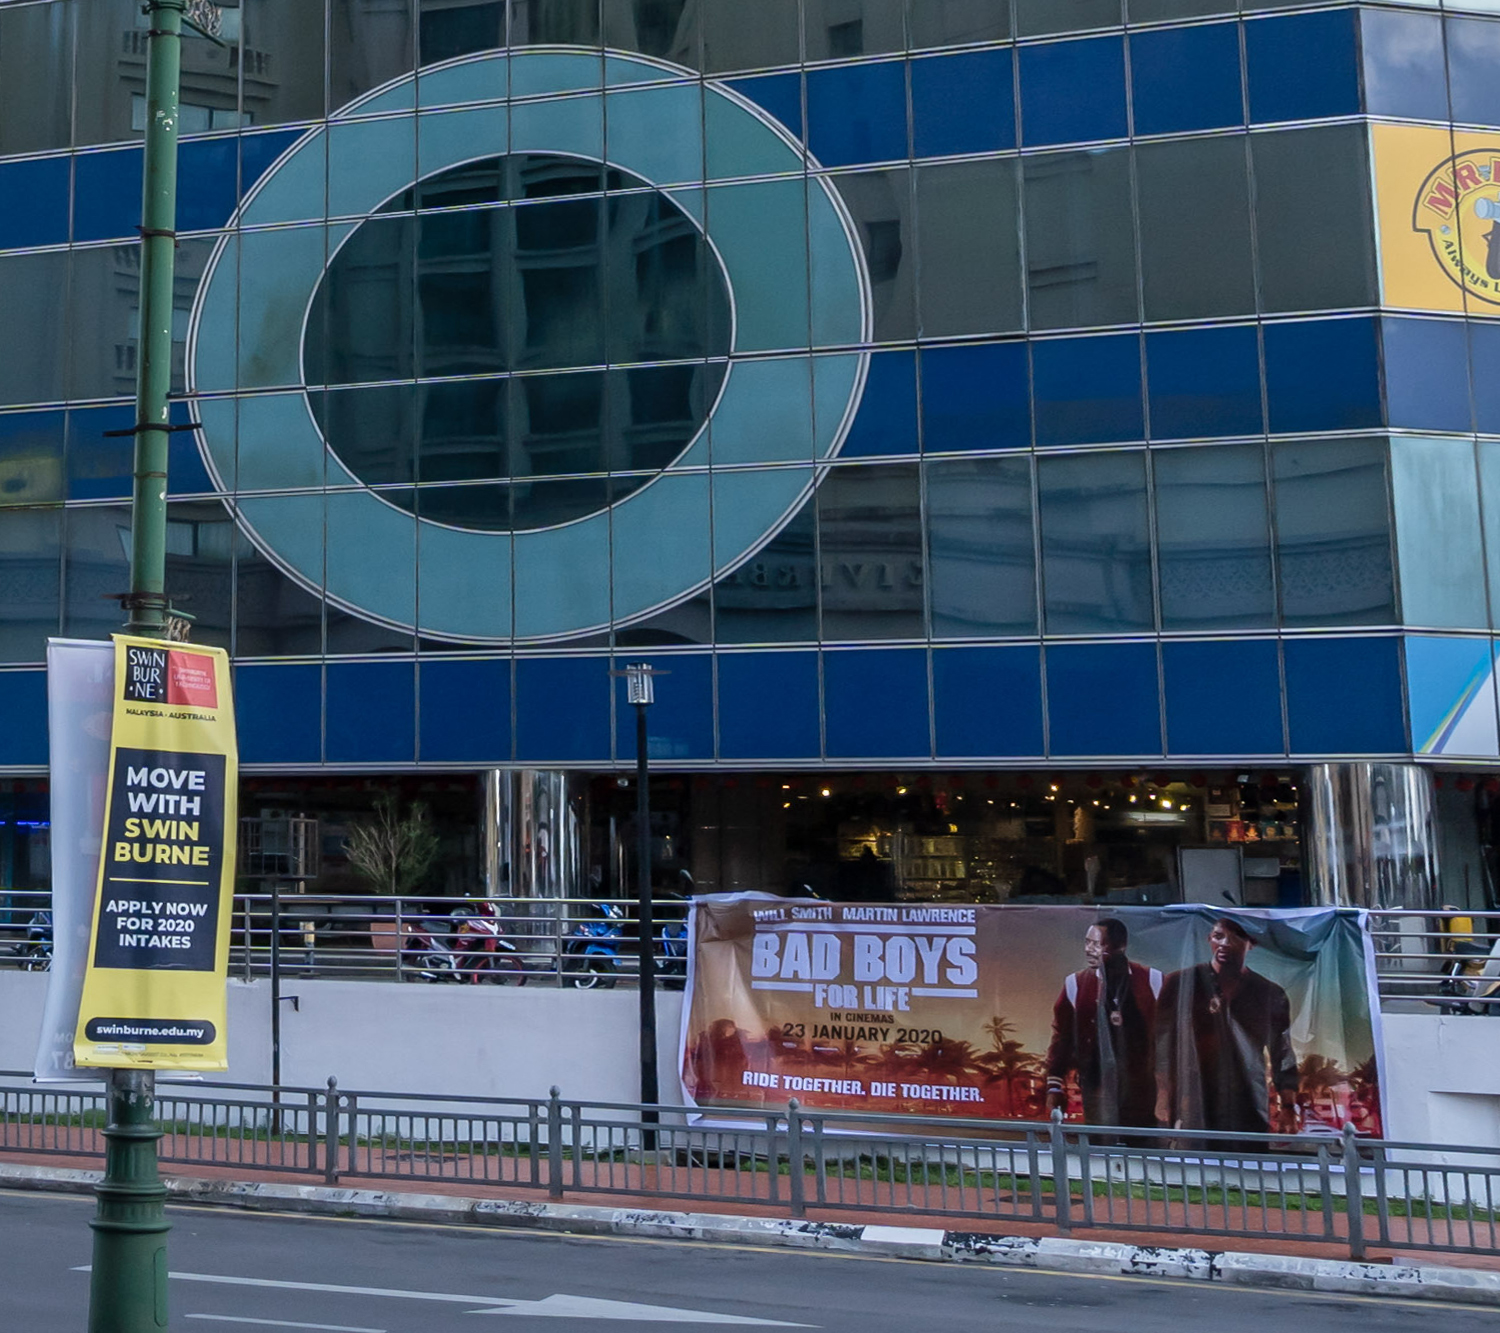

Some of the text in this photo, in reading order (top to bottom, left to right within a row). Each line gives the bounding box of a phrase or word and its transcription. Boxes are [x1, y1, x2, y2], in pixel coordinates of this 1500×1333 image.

[1423, 161, 1484, 219] MR
[1442, 239, 1489, 289] Always
[133, 665, 161, 684] BUR
[126, 708, 217, 722] MALAYSIA AUSTRALIA
[127, 766, 206, 791] MOVE
[127, 792, 201, 816] WITH
[124, 818, 200, 841] SWIN
[114, 842, 210, 866] BURNE
[106, 899, 208, 917] APPLY NOW
[753, 907, 976, 923] WILL SMITH MARTIN LAWRENCE
[116, 916, 195, 933] FOR 2020
[119, 933, 191, 949] INTAKES
[751, 932, 978, 985] BAD BOYS
[814, 984, 910, 1012] FOR LIFE
[830, 1012, 895, 1025] IN CINEMAS
[96, 1023, 204, 1039] swinburne.edu.my
[782, 1023, 943, 1045] 23 JANUARY 2020
[742, 1071, 985, 1103] RIDE TOGETHER. DIE TOGETHER.
